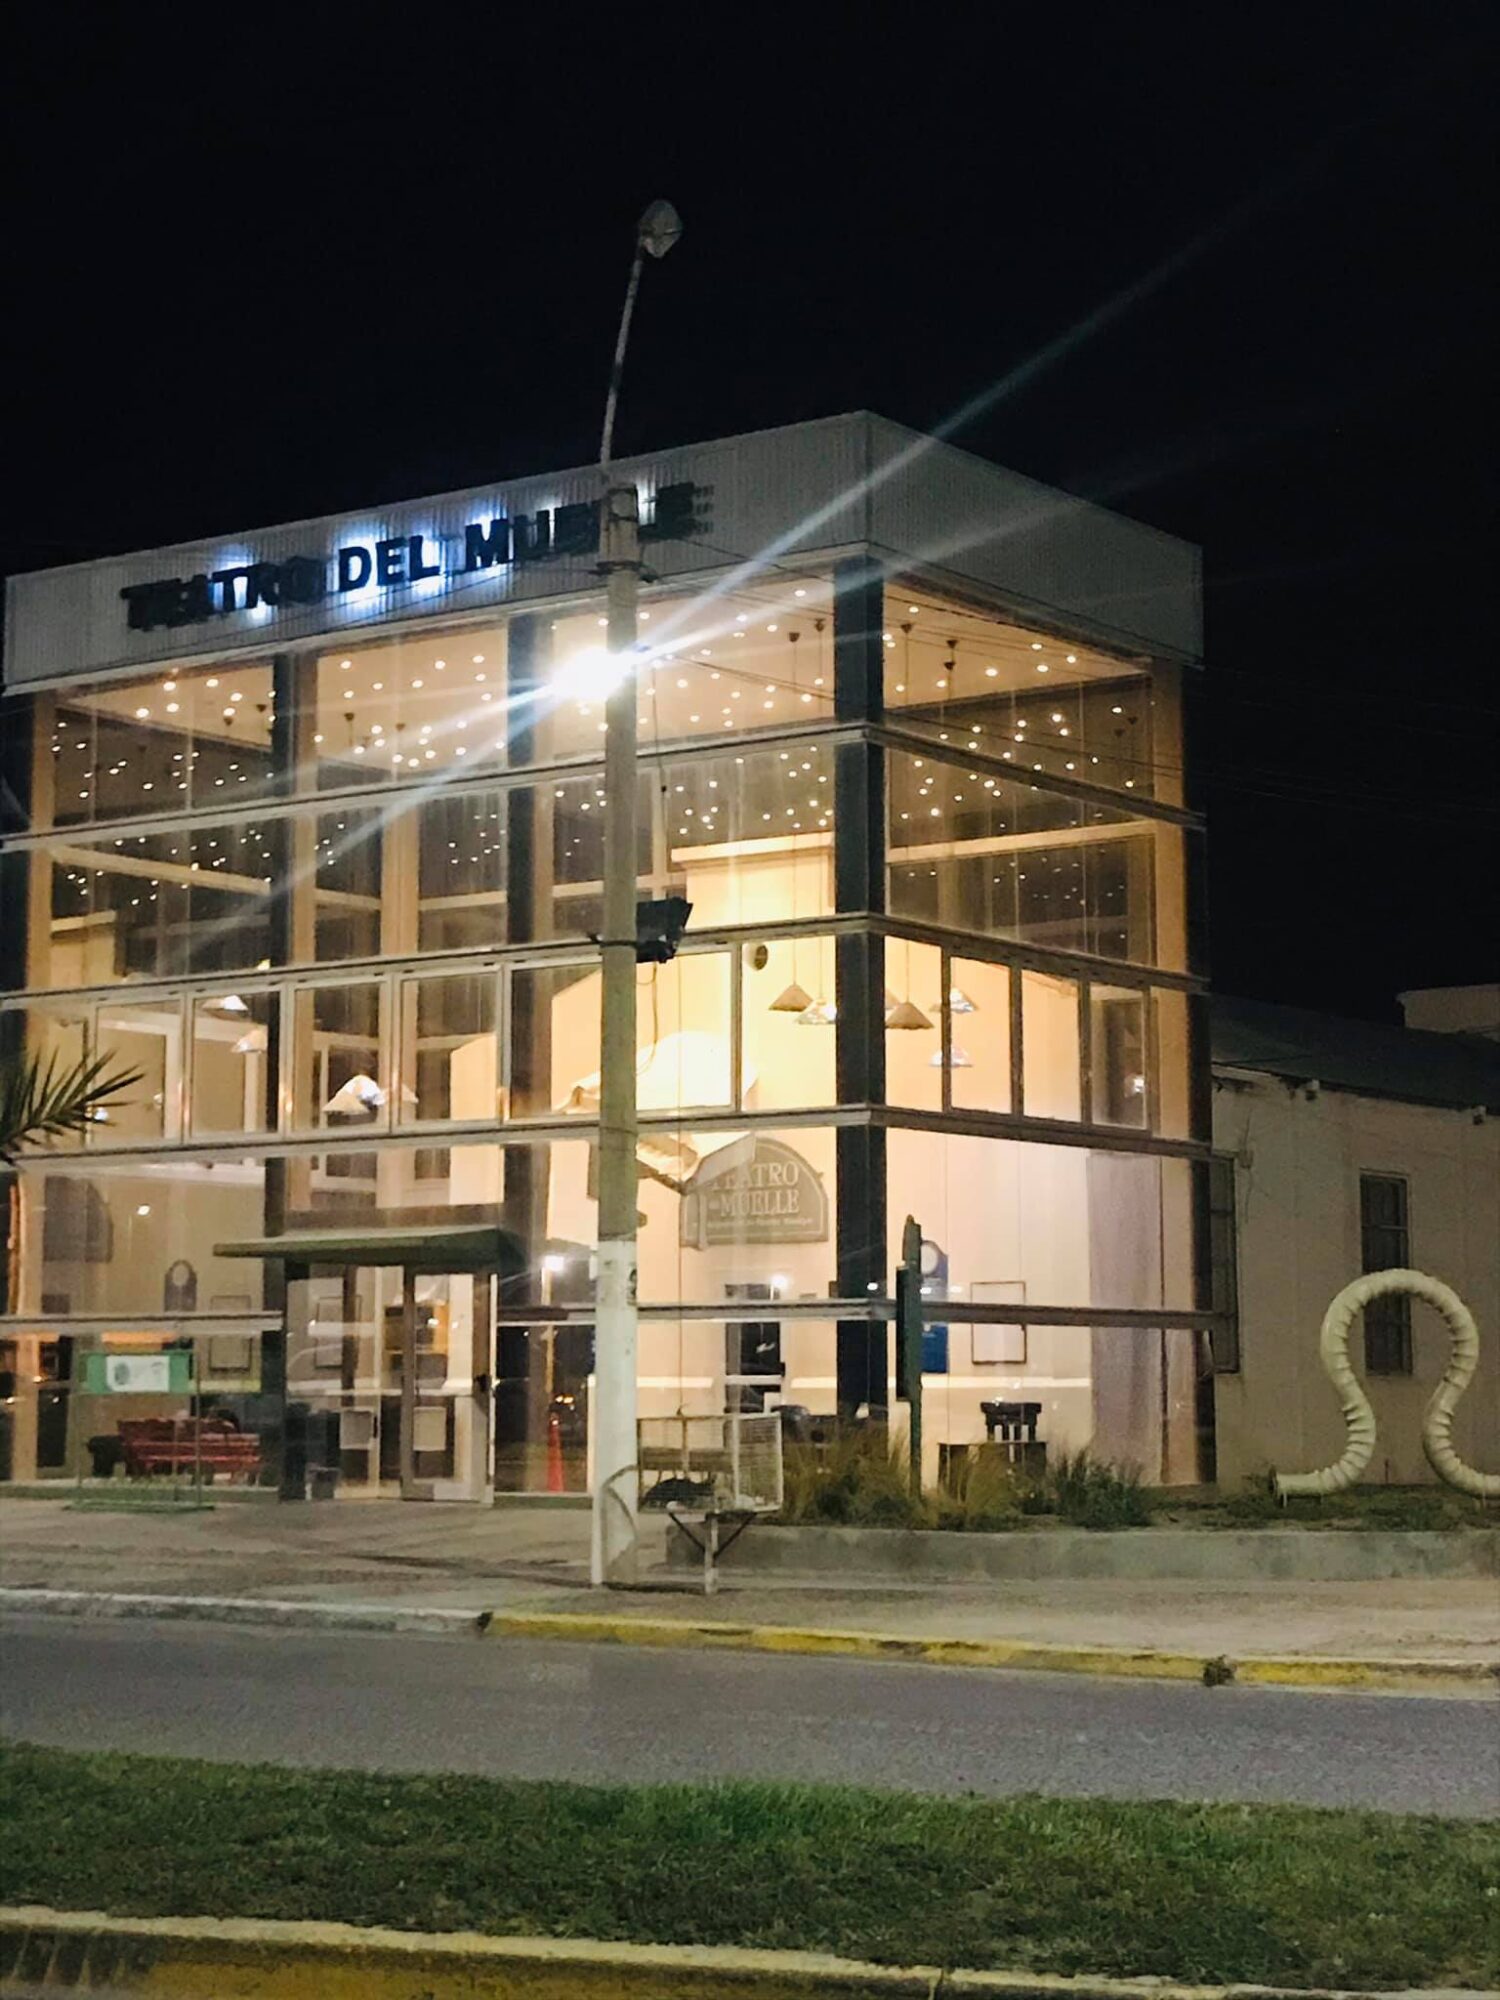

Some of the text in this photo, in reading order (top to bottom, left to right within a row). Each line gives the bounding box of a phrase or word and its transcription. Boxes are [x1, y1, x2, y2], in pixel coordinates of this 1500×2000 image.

[337, 533, 441, 594] DEL
[464, 481, 713, 572] MULE
[719, 1188, 801, 1218] MUELLE
